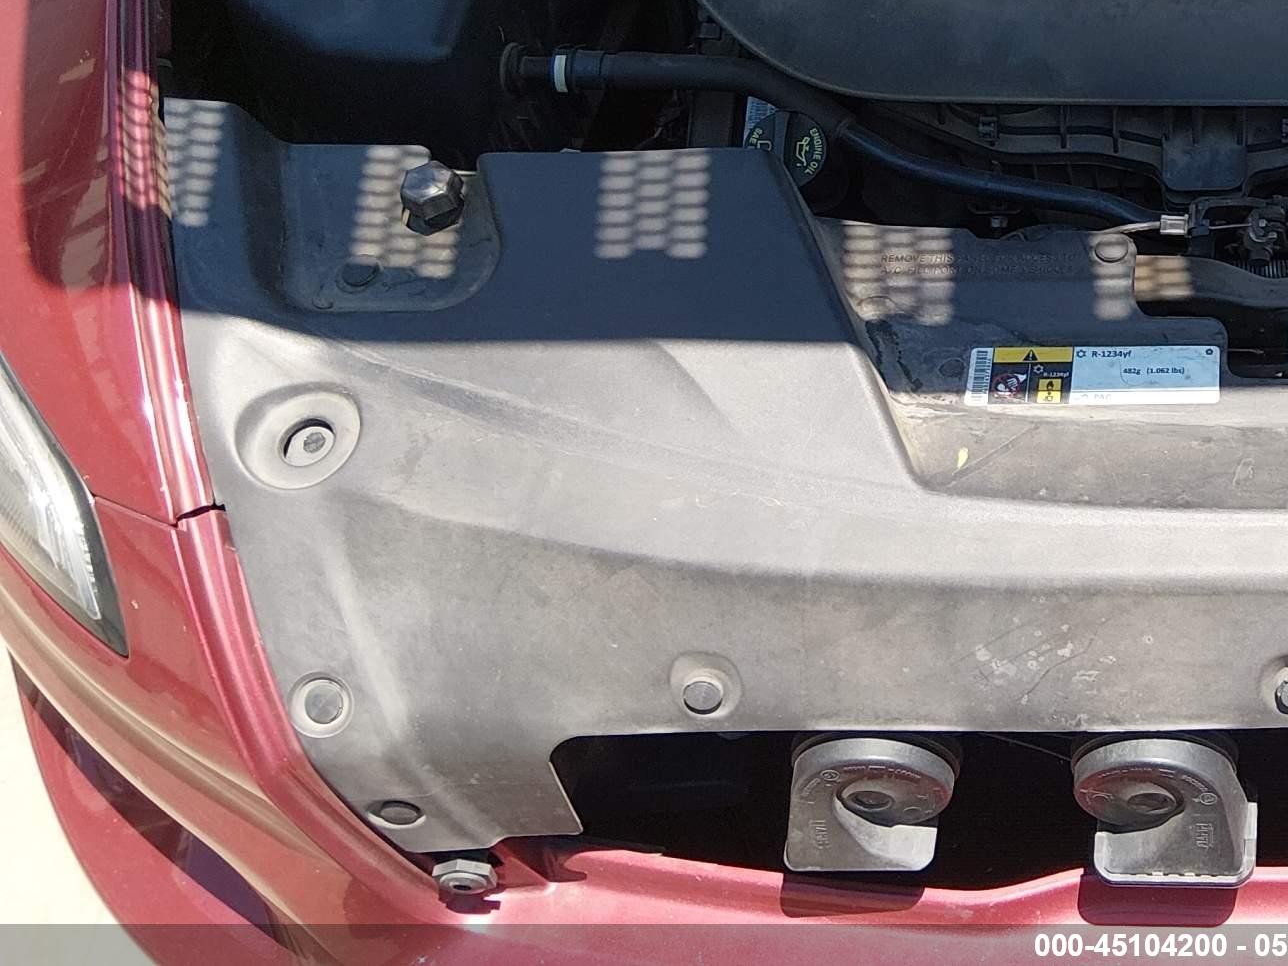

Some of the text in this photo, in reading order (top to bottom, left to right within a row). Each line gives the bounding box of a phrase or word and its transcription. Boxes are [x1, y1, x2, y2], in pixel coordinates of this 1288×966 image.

[804, 127, 823, 175] ENGINE OIL
[880, 253, 926, 265] REMOVE
[927, 253, 954, 265] THIS
[1091, 350, 1132, 359] R-1234yf
[1122, 366, 1185, 376] 482g (1.062 lbs)
